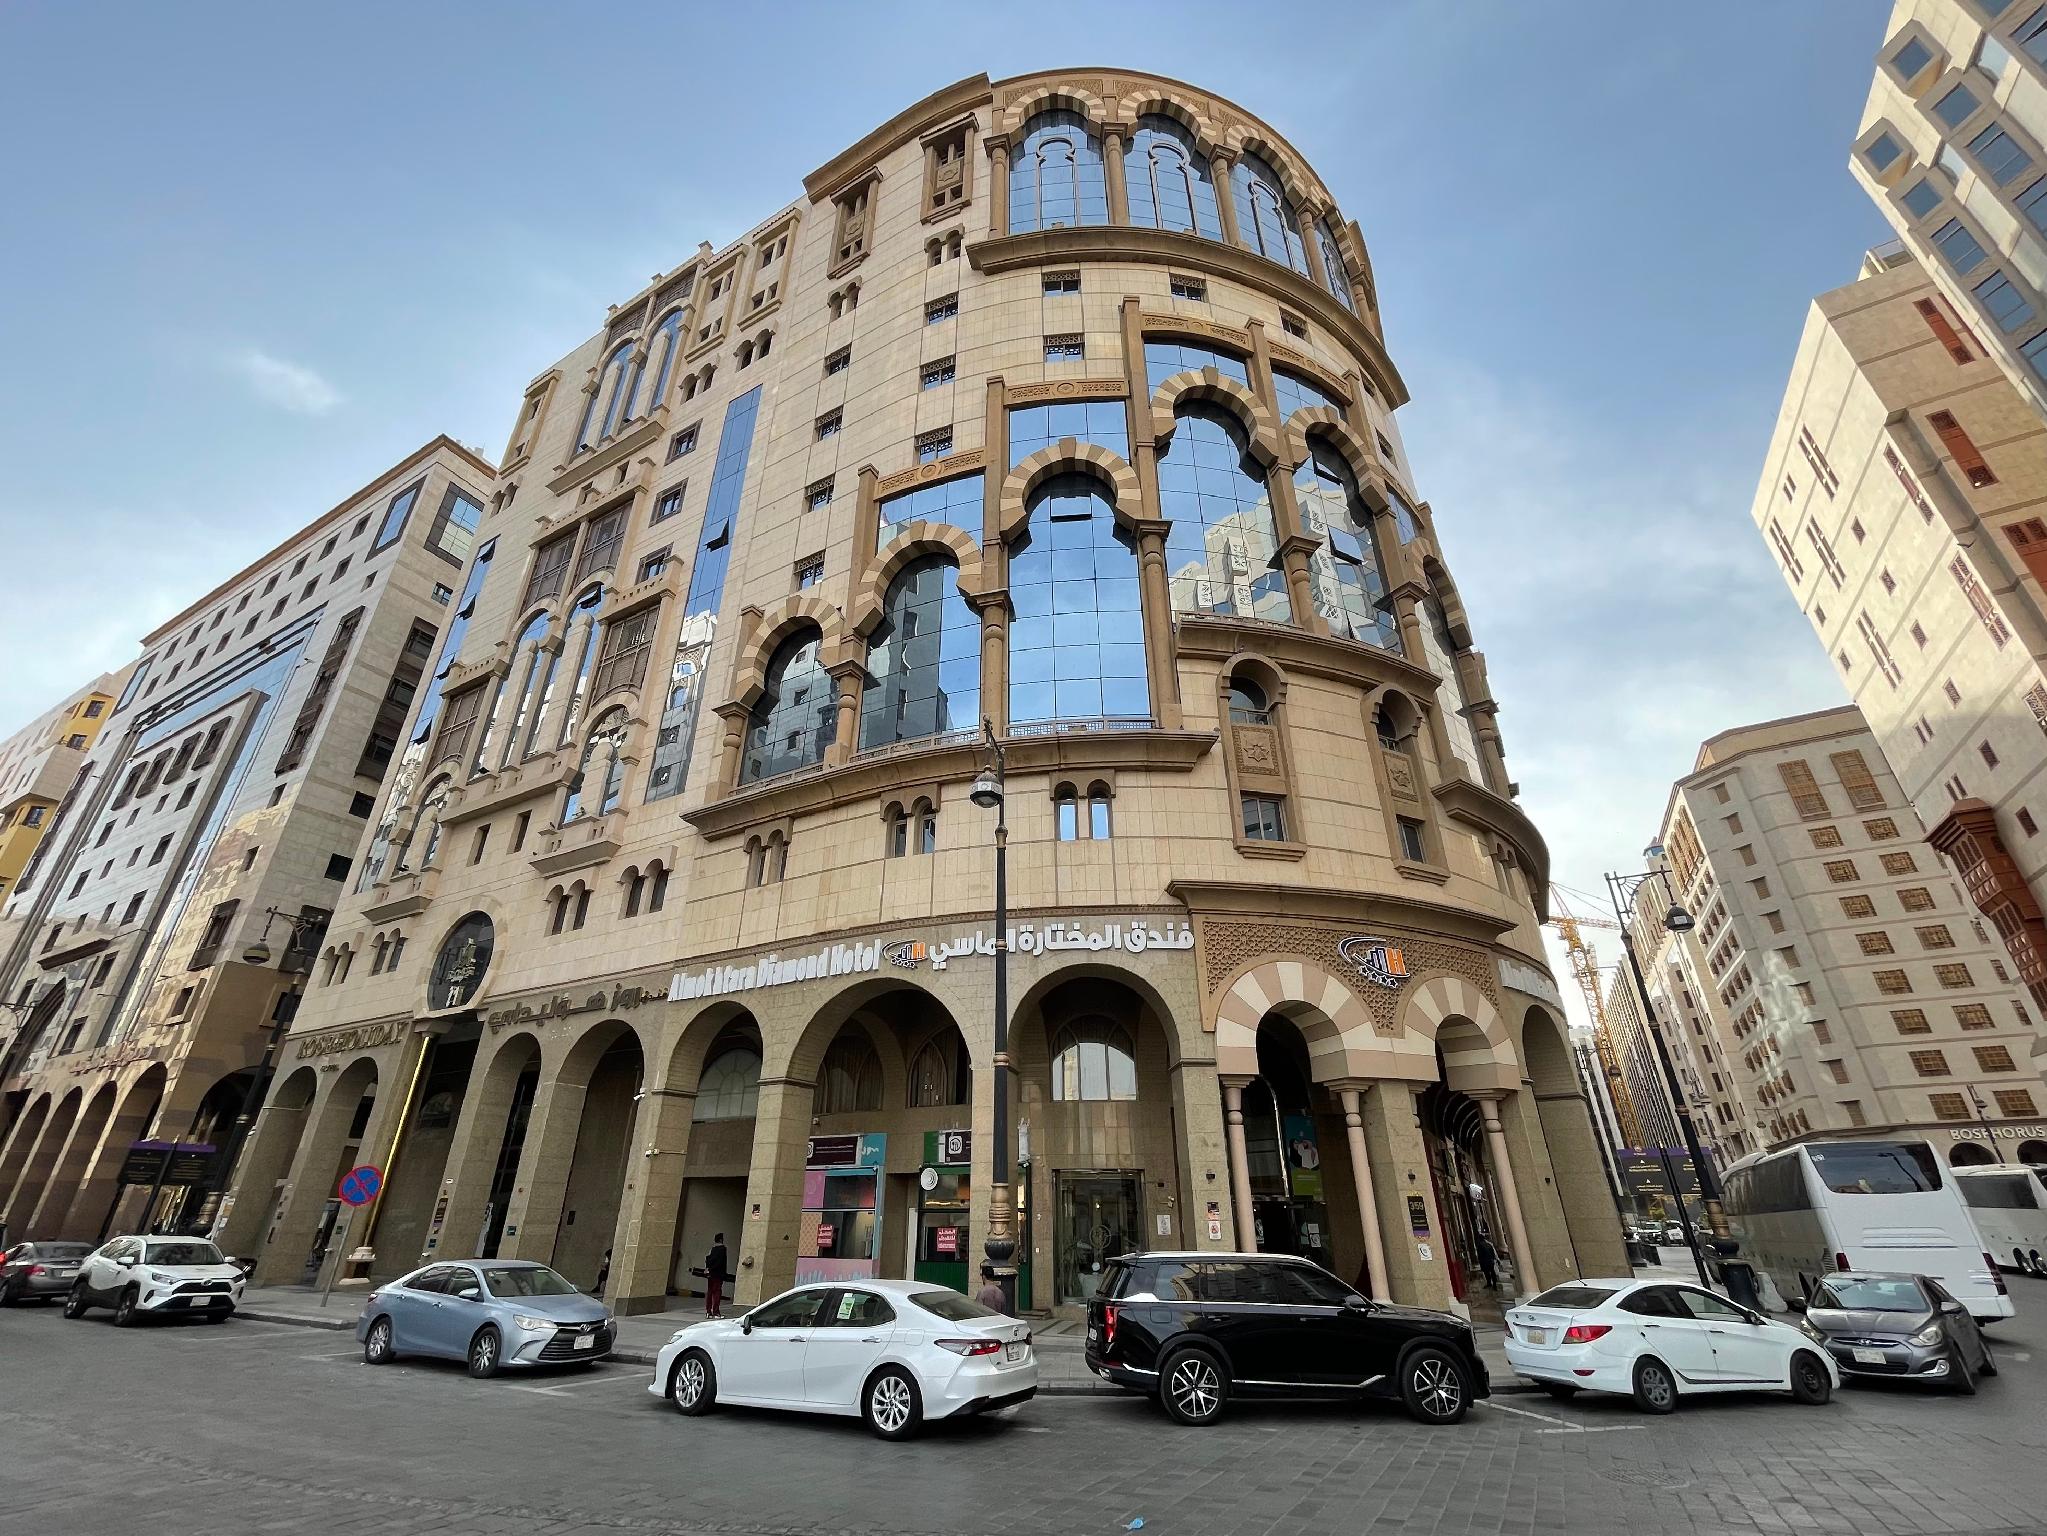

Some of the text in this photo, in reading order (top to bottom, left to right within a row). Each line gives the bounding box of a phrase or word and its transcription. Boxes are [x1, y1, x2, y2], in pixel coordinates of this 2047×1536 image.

[1020, 923, 1122, 957] المختارة
[1123, 921, 1195, 953] فندق
[756, 946, 830, 987] Diamond
[829, 938, 882, 977] Hotel
[1949, 1125, 2046, 1141] BOSPHORUS
